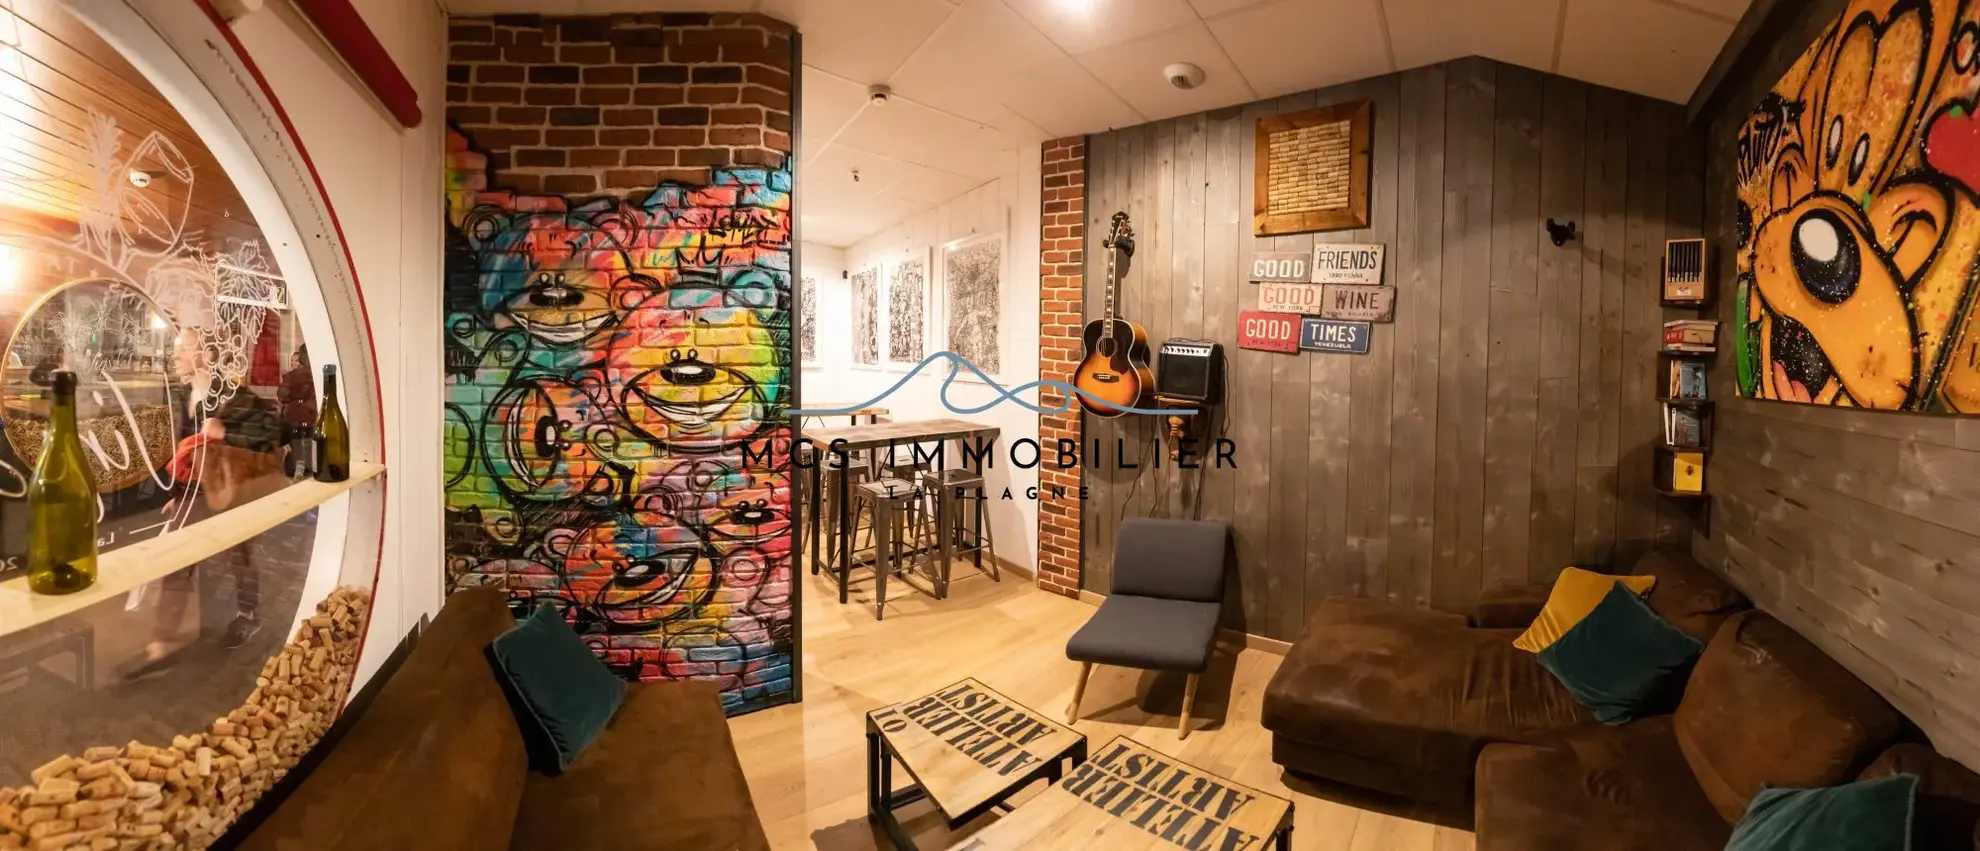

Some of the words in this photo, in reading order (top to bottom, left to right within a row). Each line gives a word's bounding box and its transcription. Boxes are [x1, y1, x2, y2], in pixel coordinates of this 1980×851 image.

[1253, 259, 1304, 278] GOOD
[1318, 250, 1377, 270] FRIENDS
[1263, 286, 1315, 305] GOOD
[1334, 289, 1380, 310] WINE
[1245, 318, 1291, 341] GOOD
[1310, 323, 1357, 343] TIMES
[1314, 341, 1352, 349] VENEZUELA
[936, 684, 1058, 746] ARTIST
[902, 696, 1043, 776] ATELIER
[1089, 743, 1256, 820] ARTIST
[1061, 763, 1260, 851] ATELIER
